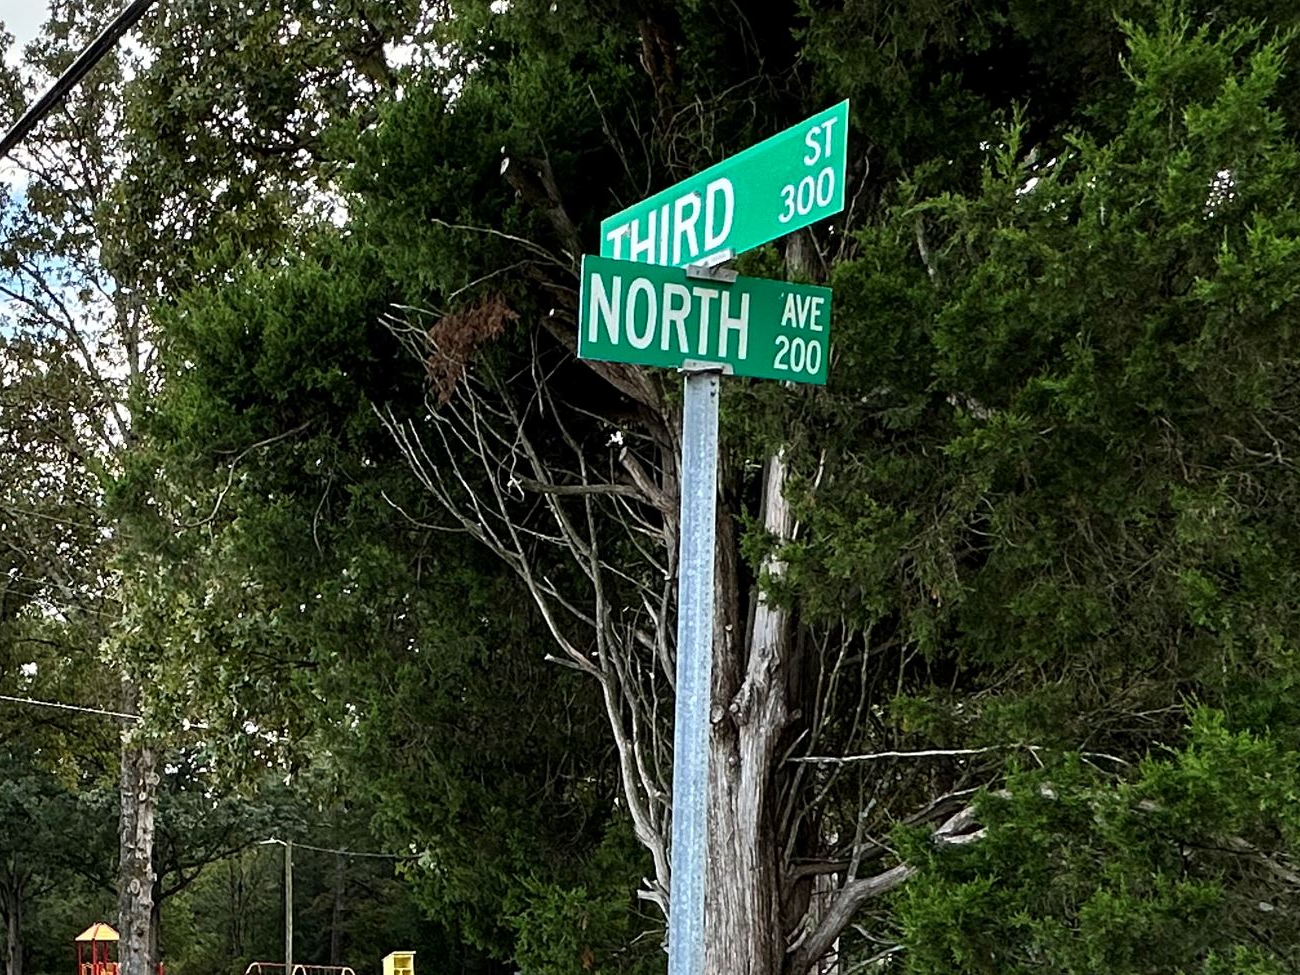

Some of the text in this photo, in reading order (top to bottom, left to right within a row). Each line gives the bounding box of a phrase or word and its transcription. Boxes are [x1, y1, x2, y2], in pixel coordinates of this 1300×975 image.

[606, 116, 839, 267] THIRD ST
[777, 166, 836, 224] 300
[588, 272, 825, 361] NORTH AVE
[772, 335, 822, 376] 200
